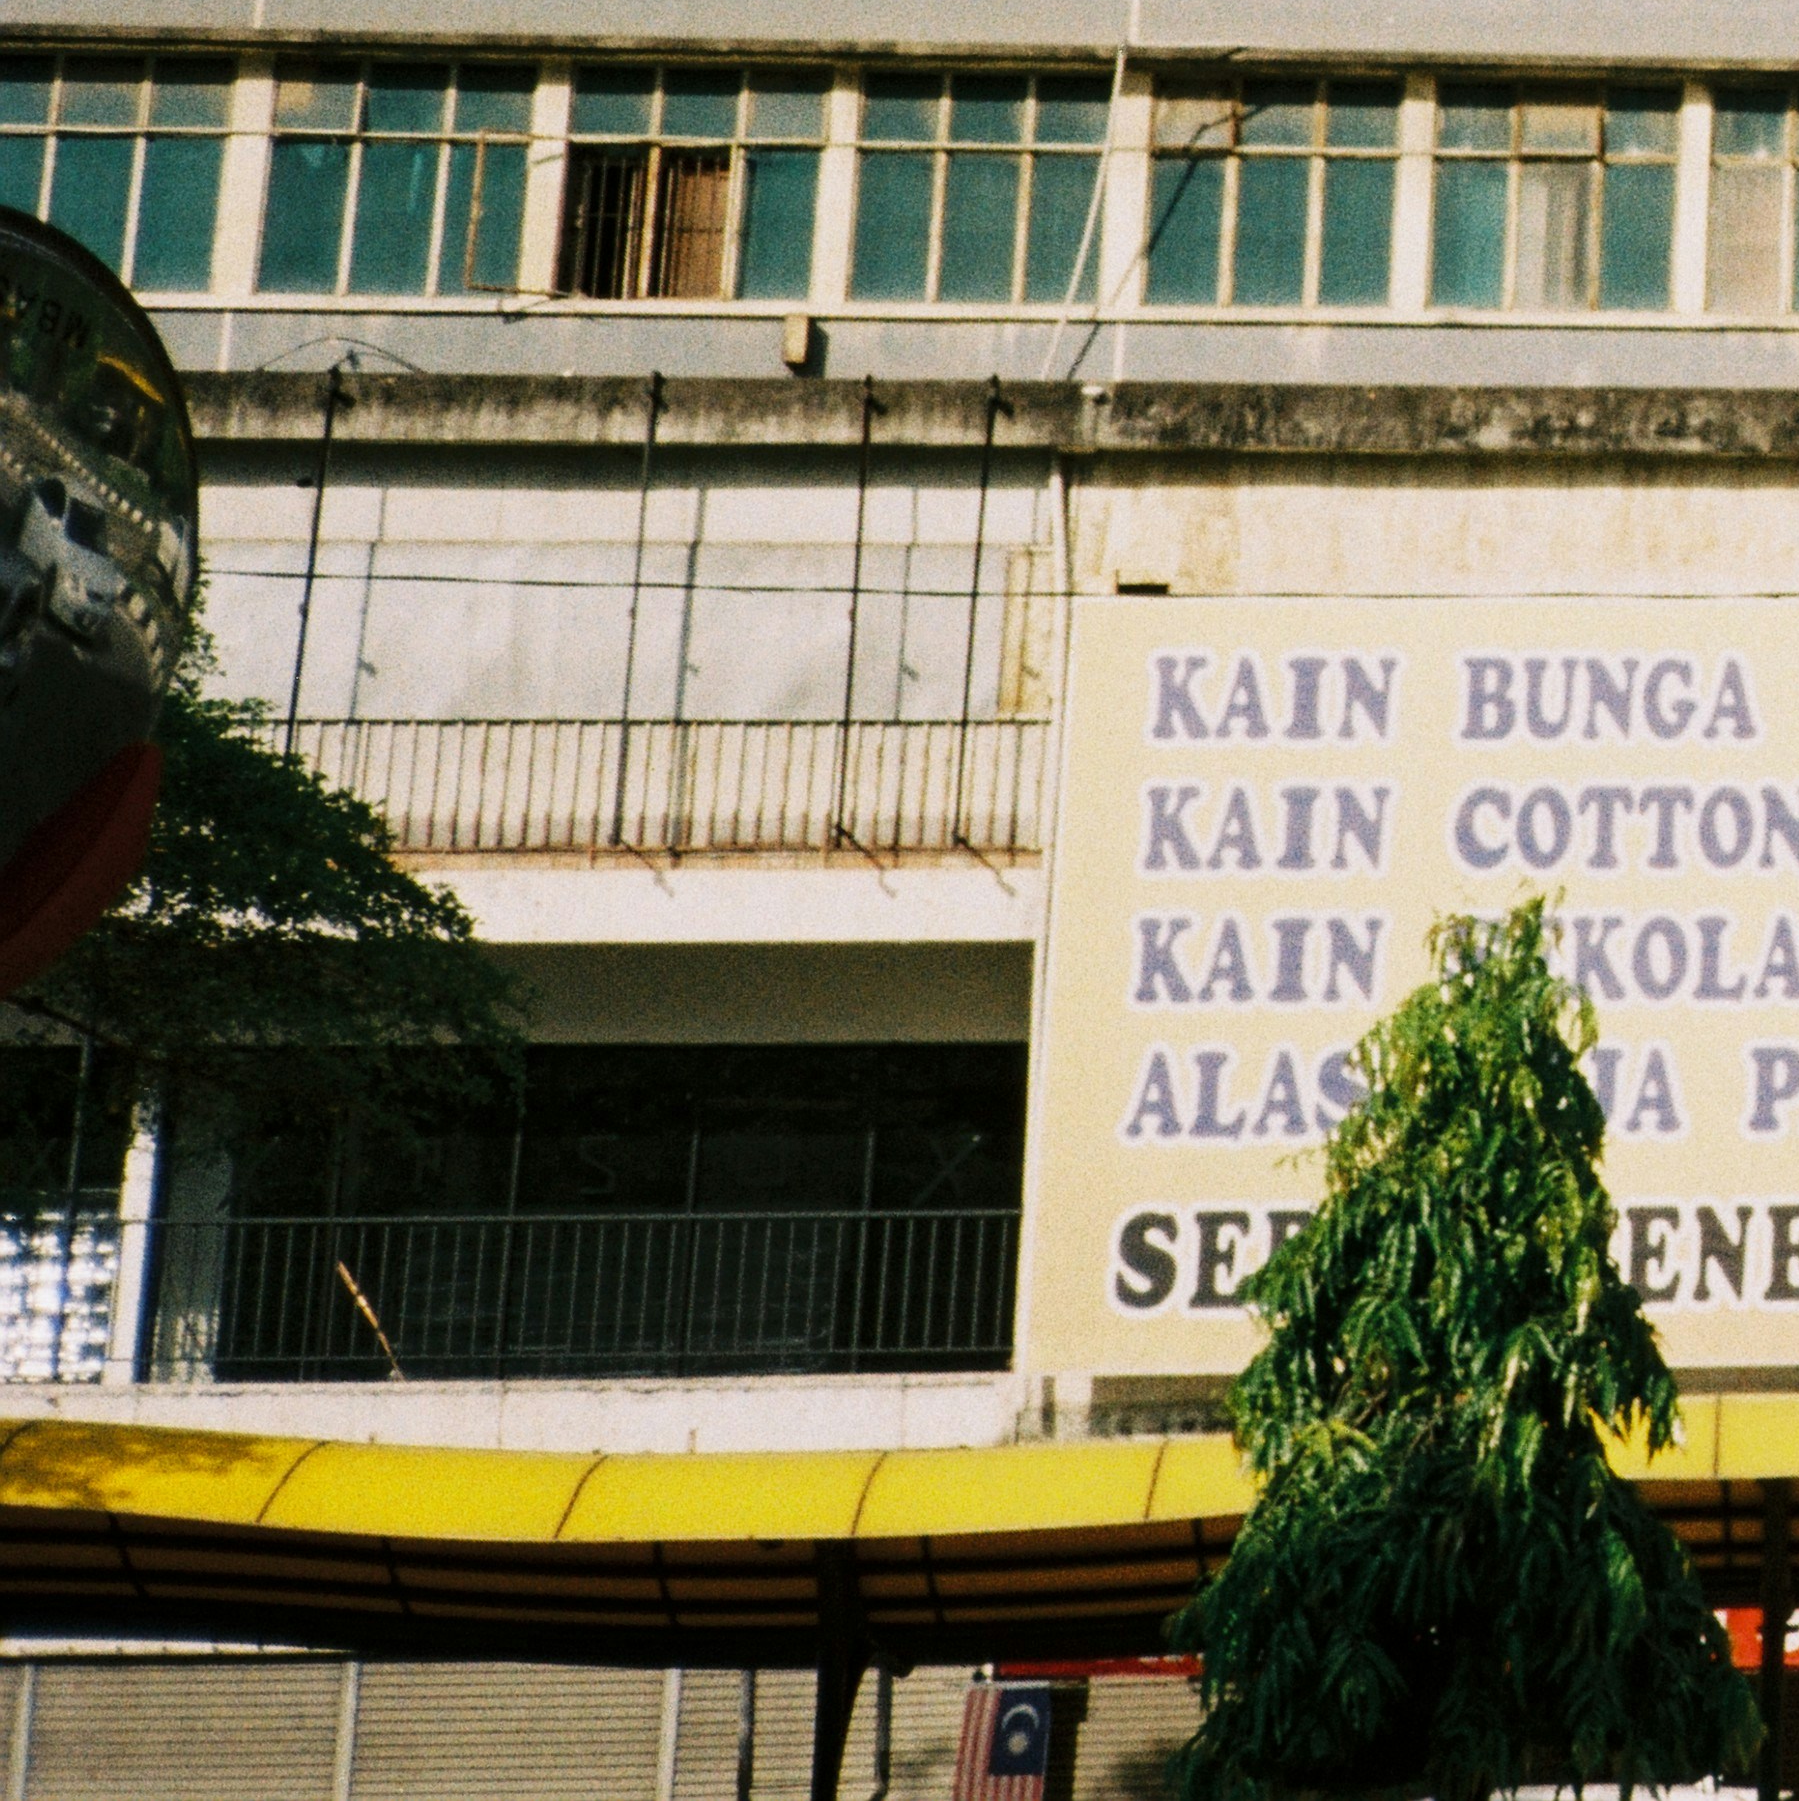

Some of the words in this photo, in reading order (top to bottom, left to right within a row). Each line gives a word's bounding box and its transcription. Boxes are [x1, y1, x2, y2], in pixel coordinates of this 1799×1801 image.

[1153, 656, 1396, 740] KAIN
[1461, 657, 1756, 740] BUNGA
[1144, 786, 1390, 871] KAIN
[1134, 918, 1382, 1004] KAIN
